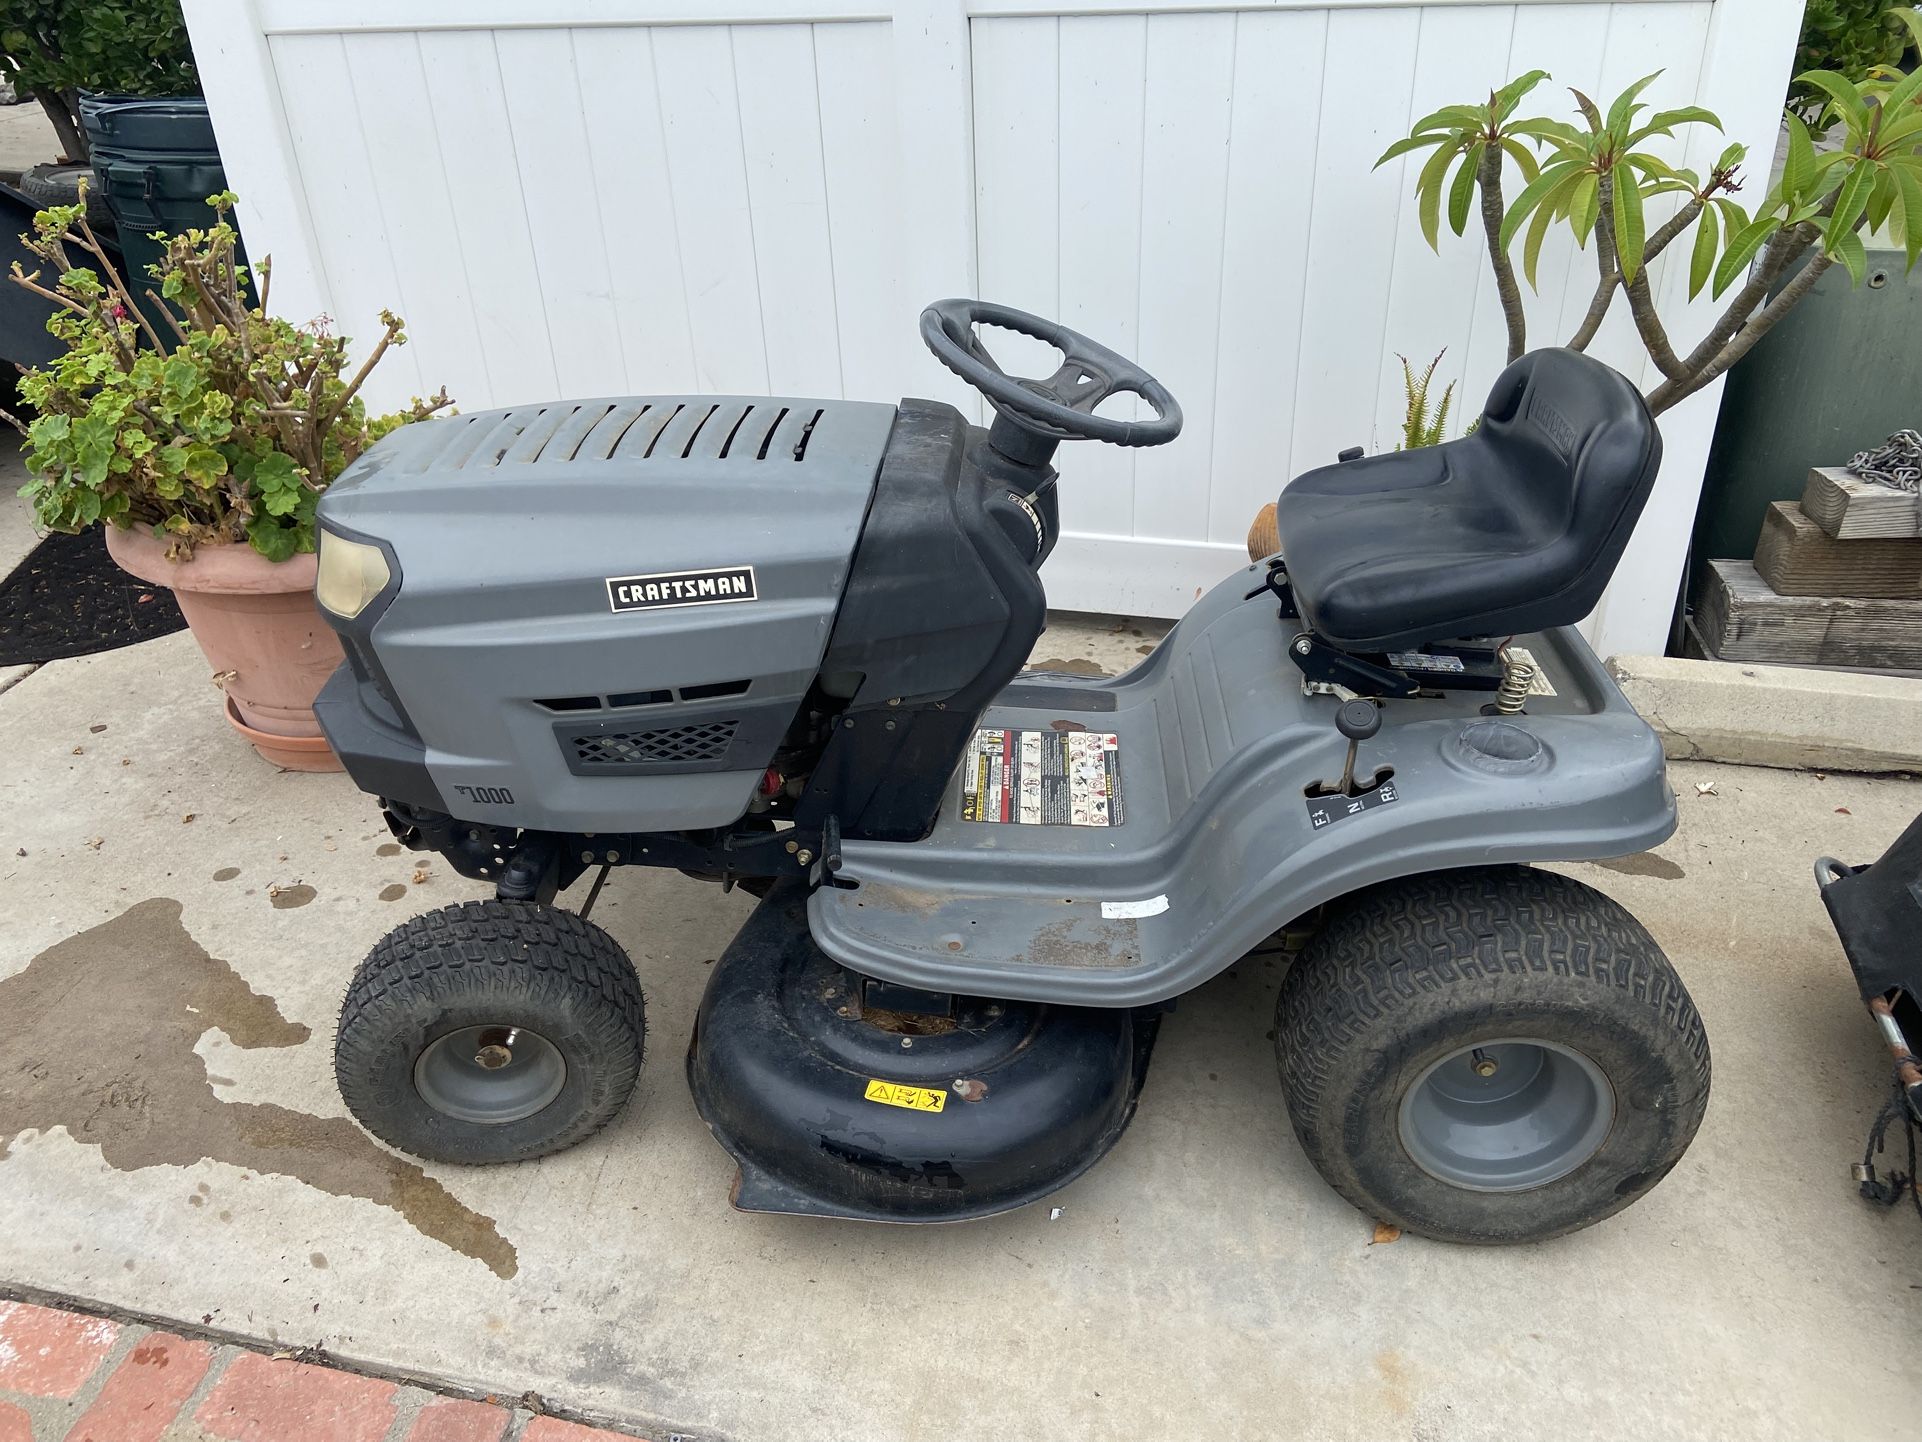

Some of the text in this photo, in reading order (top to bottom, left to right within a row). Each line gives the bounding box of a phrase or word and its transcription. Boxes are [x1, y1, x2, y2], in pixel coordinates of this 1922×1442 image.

[617, 575, 747, 603] CRAFTSMAN
[1381, 791, 1394, 802] R
[1347, 802, 1361, 814] N
[1314, 818, 1327, 827] F
